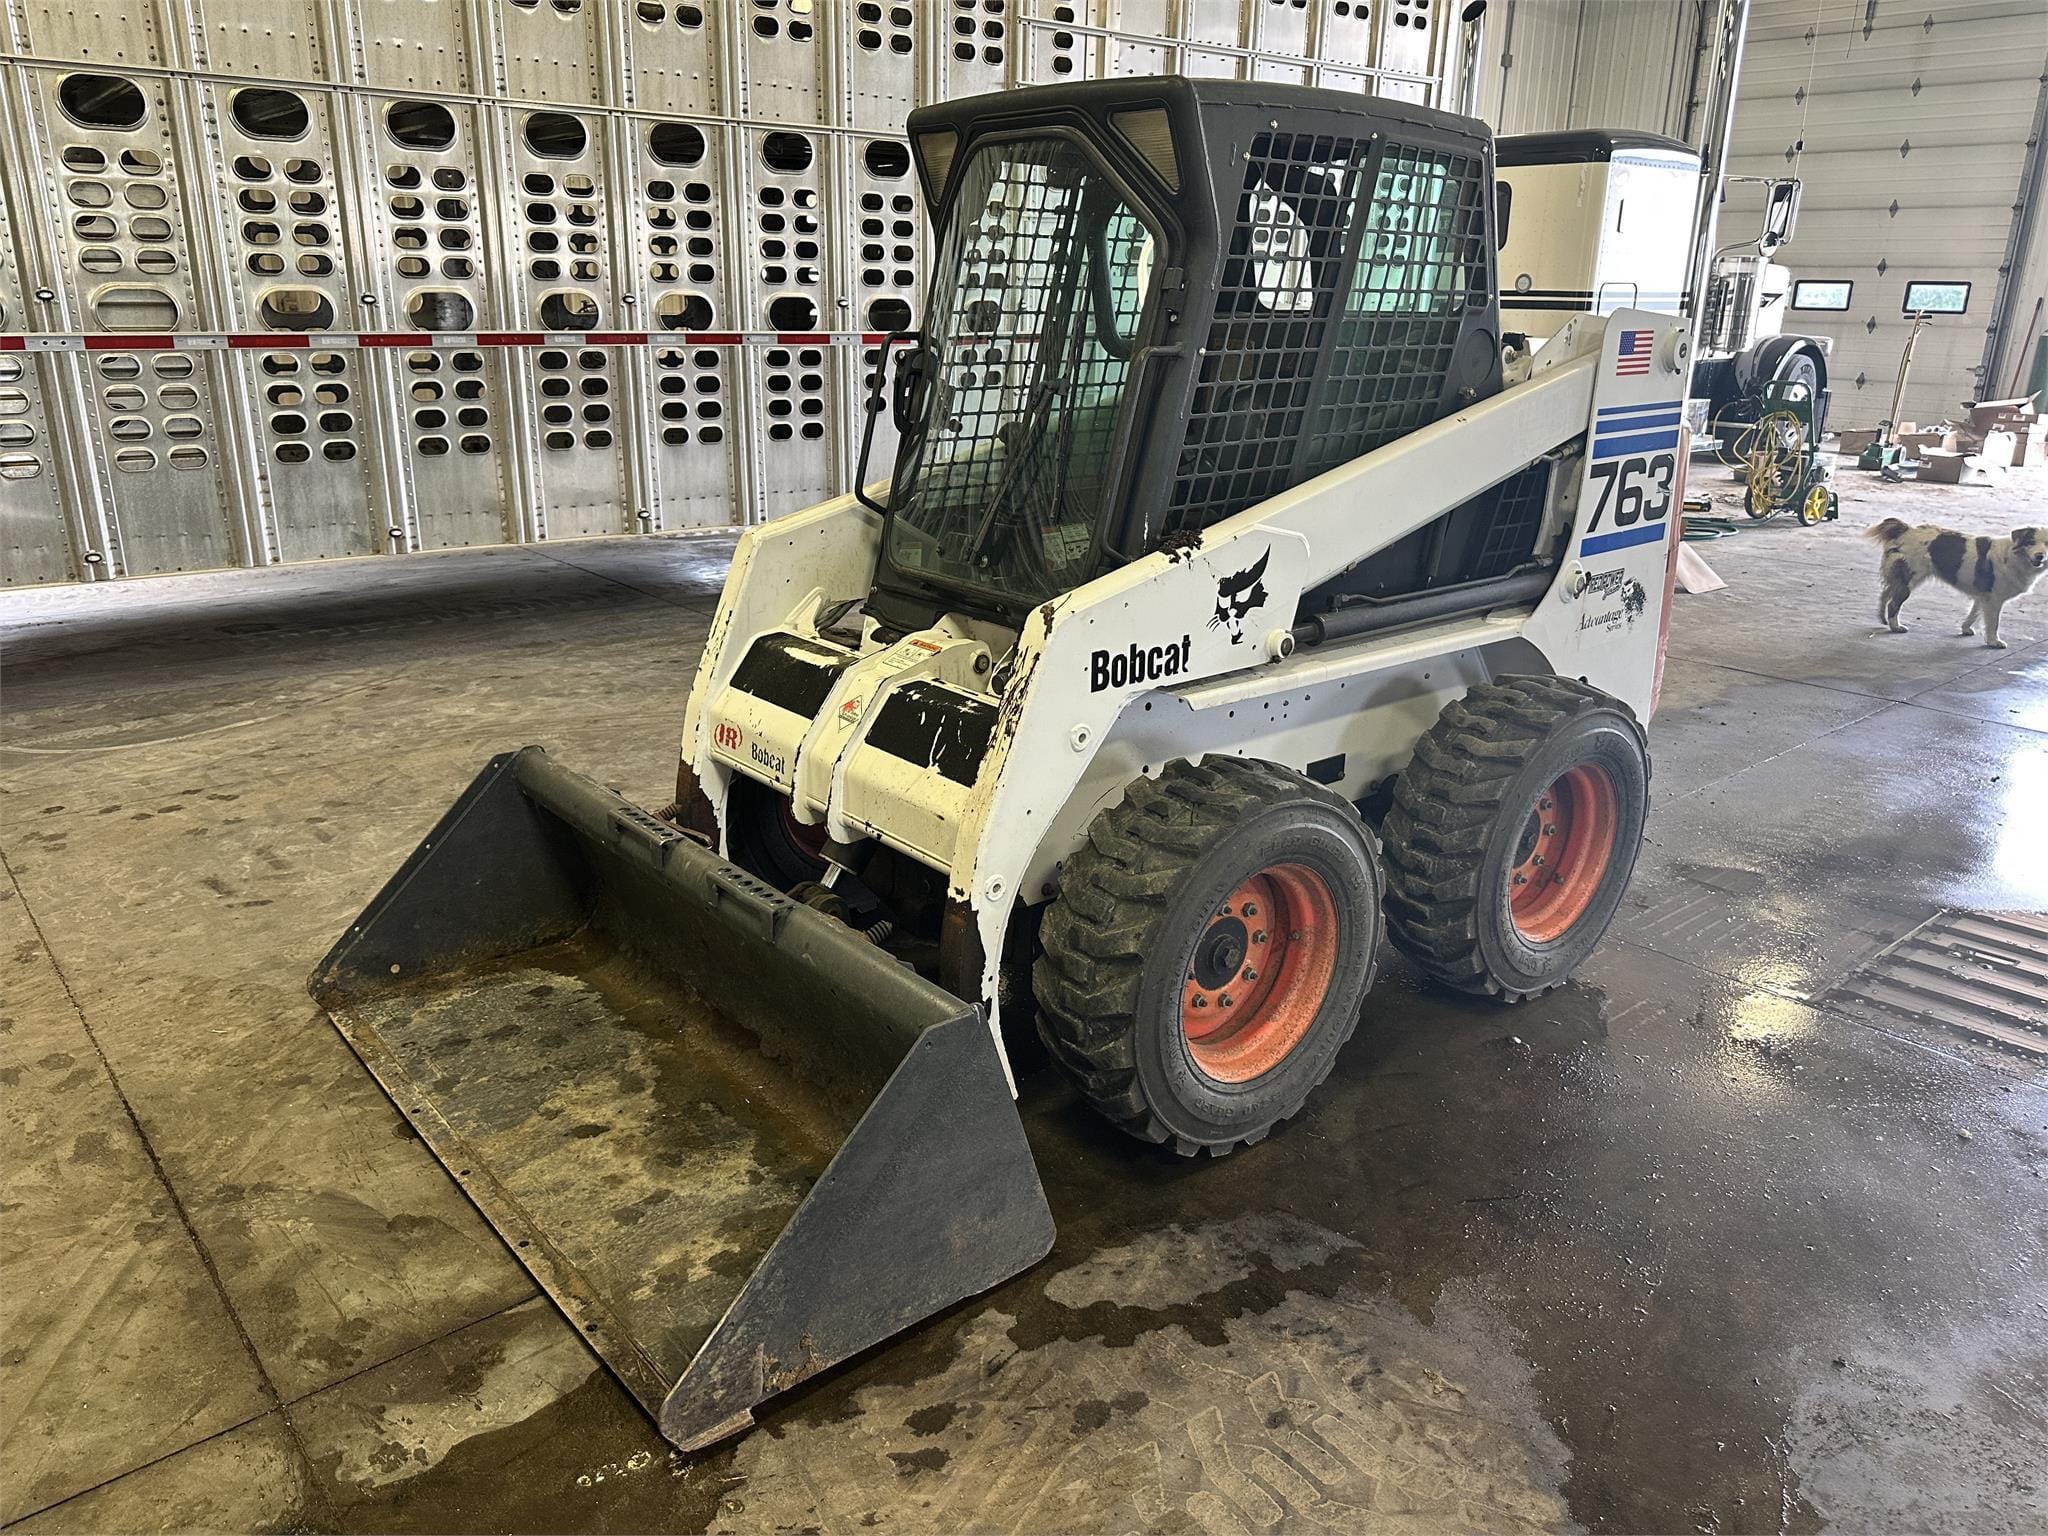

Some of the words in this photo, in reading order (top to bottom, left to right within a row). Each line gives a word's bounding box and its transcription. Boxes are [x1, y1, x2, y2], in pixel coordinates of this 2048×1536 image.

[1586, 453, 1674, 534] 763
[1091, 634, 1191, 693] Bobcat
[751, 741, 785, 775] Bobcat
